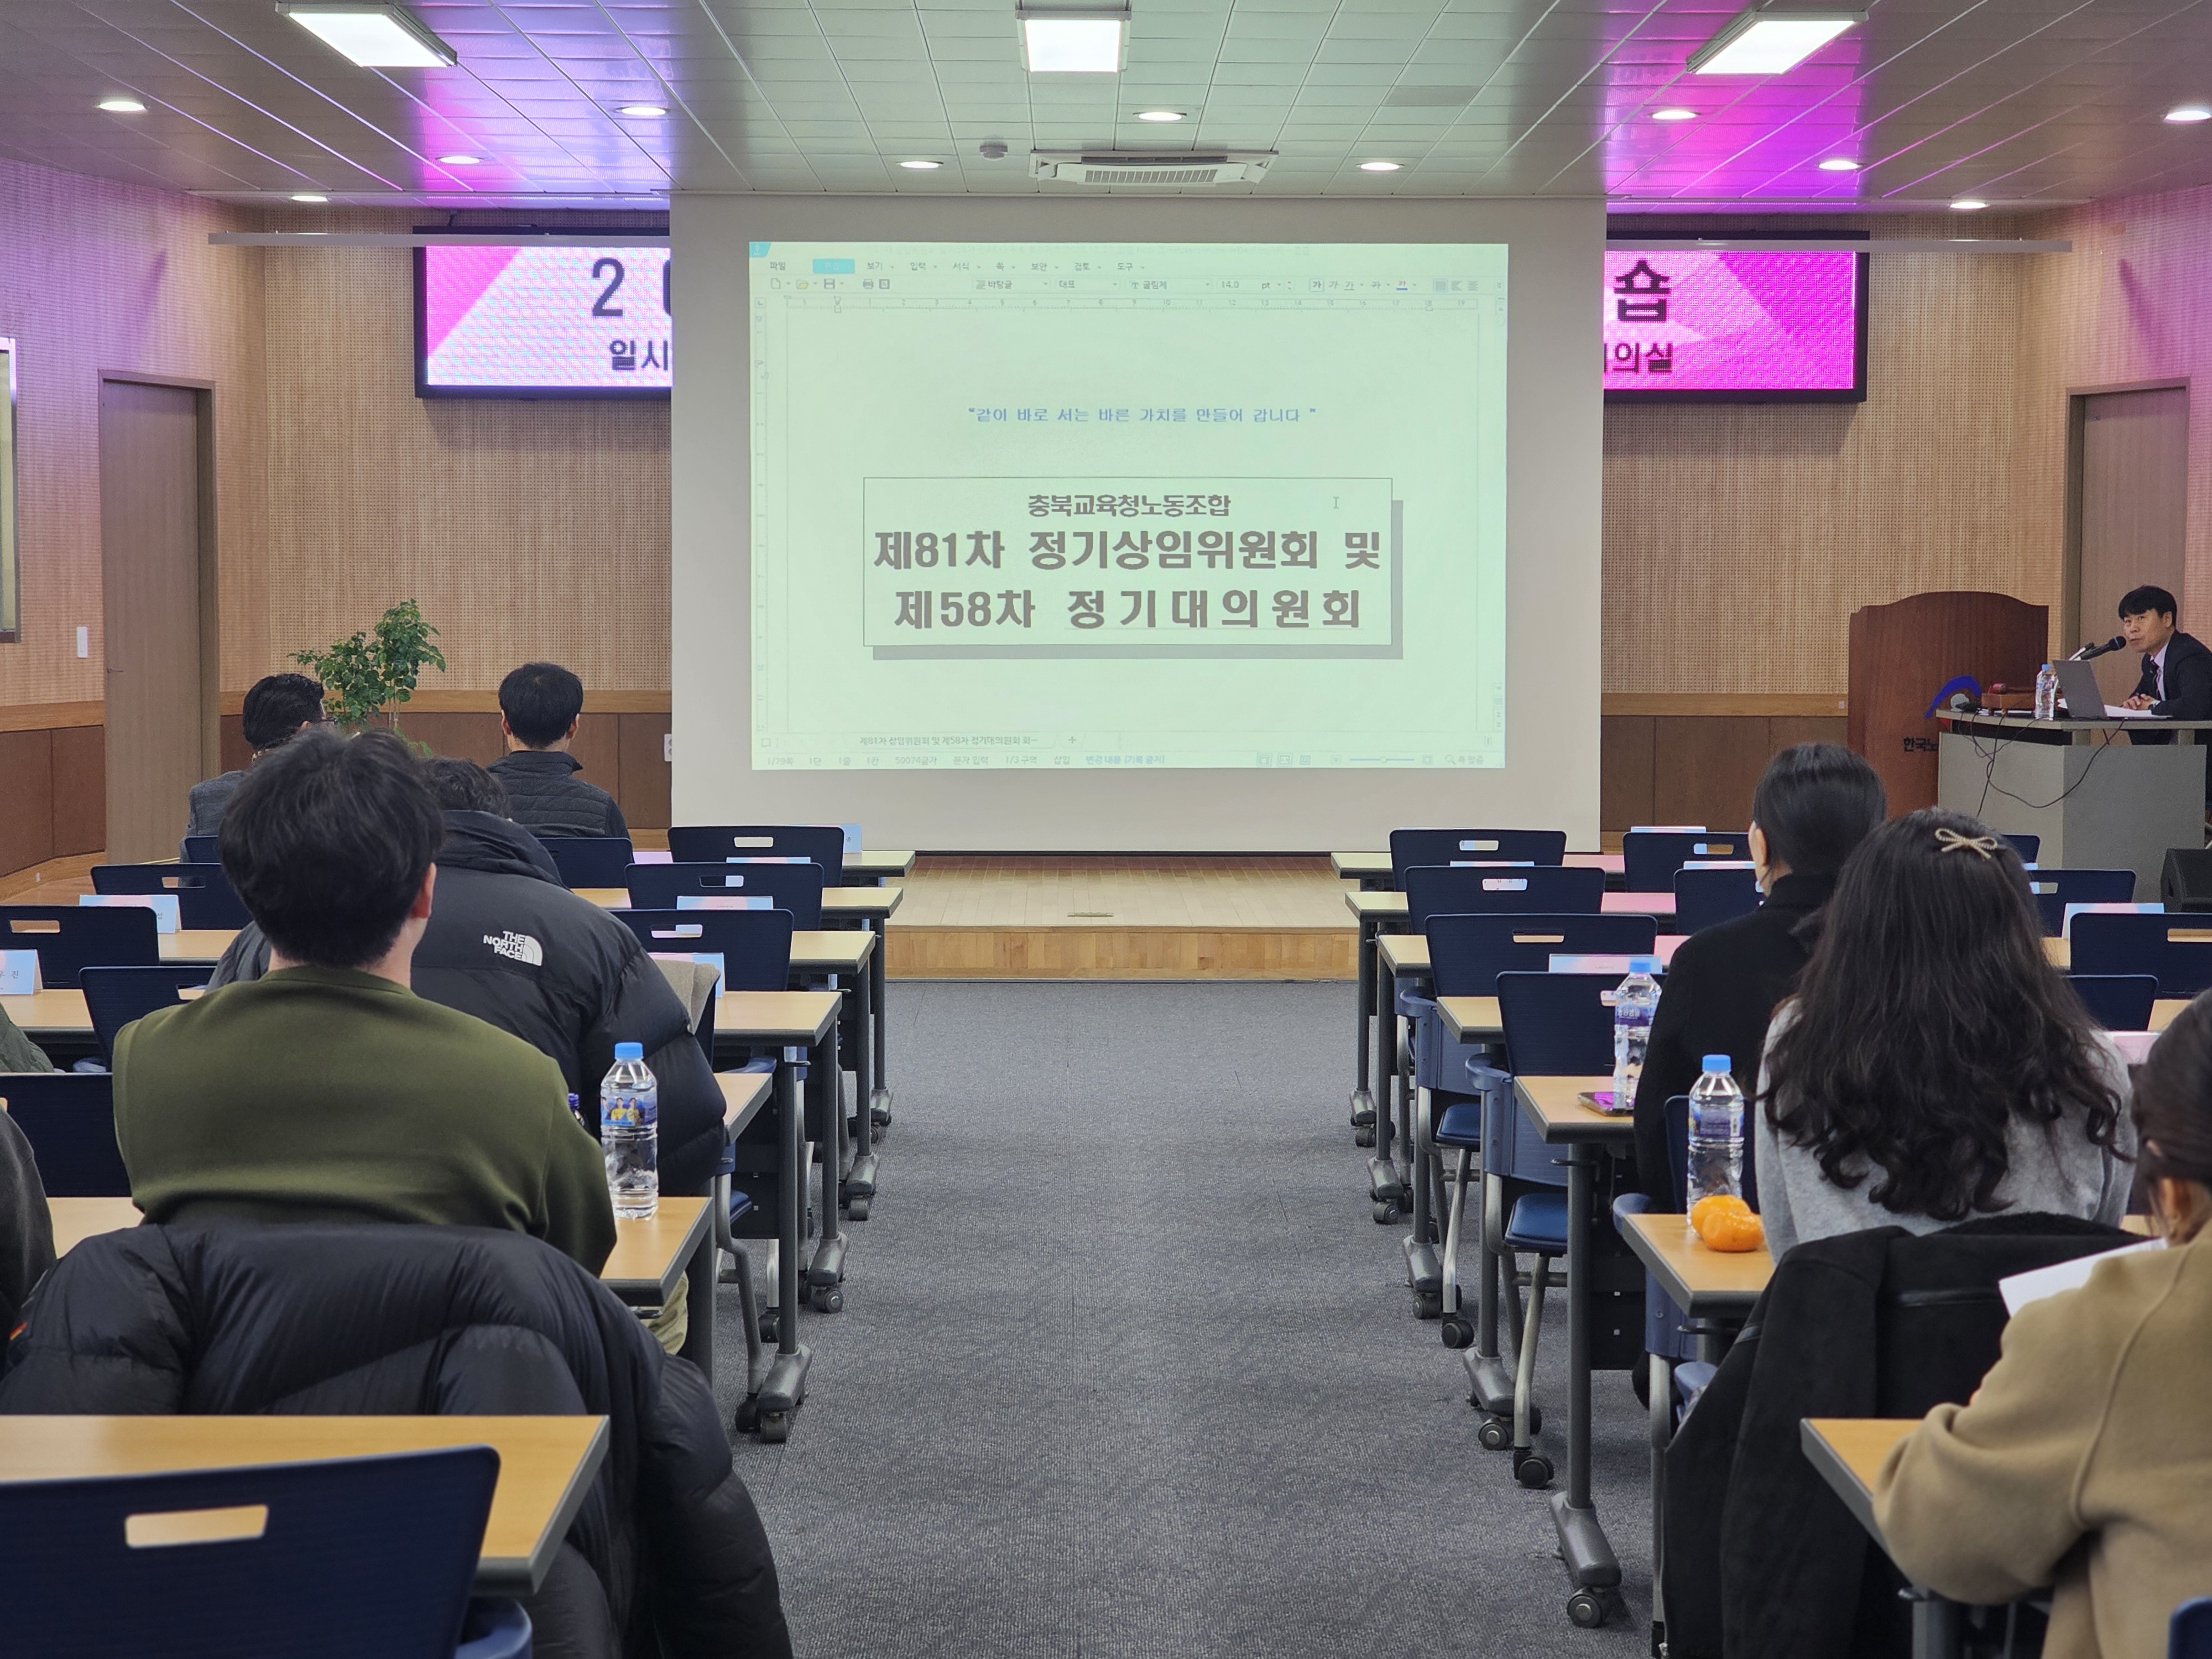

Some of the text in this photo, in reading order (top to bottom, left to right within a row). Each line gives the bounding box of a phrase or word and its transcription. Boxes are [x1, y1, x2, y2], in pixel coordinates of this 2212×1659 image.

[770, 262, 786, 270] 파일
[867, 261, 883, 270] 보기
[910, 262, 926, 270] 입력
[953, 262, 969, 270] 서식
[1031, 262, 1047, 271] 보안
[1074, 262, 1090, 270] 검토
[1117, 262, 1134, 270] 도구
[988, 280, 1013, 289] 바탕글
[609, 340, 669, 371] 일시
[1604, 343, 1673, 373] 의실
[1017, 408, 1048, 422] 바로
[1057, 408, 1089, 422] 서는
[1098, 408, 1130, 422] 바른
[1139, 408, 1187, 422] 가치를
[1196, 408, 1244, 422] 만들어
[1253, 408, 1301, 422] 갑니다
[1028, 494, 1231, 518] 충북교육청노동조합
[873, 530, 1380, 570] 제81차 정기상임위원회 및
[894, 589, 1036, 629] 제58차
[859, 737, 887, 745] 제81차
[942, 737, 969, 745] 제58차
[483, 935, 524, 953] NORTH
[503, 931, 525, 945] THE
[494, 945, 522, 961] FACE
